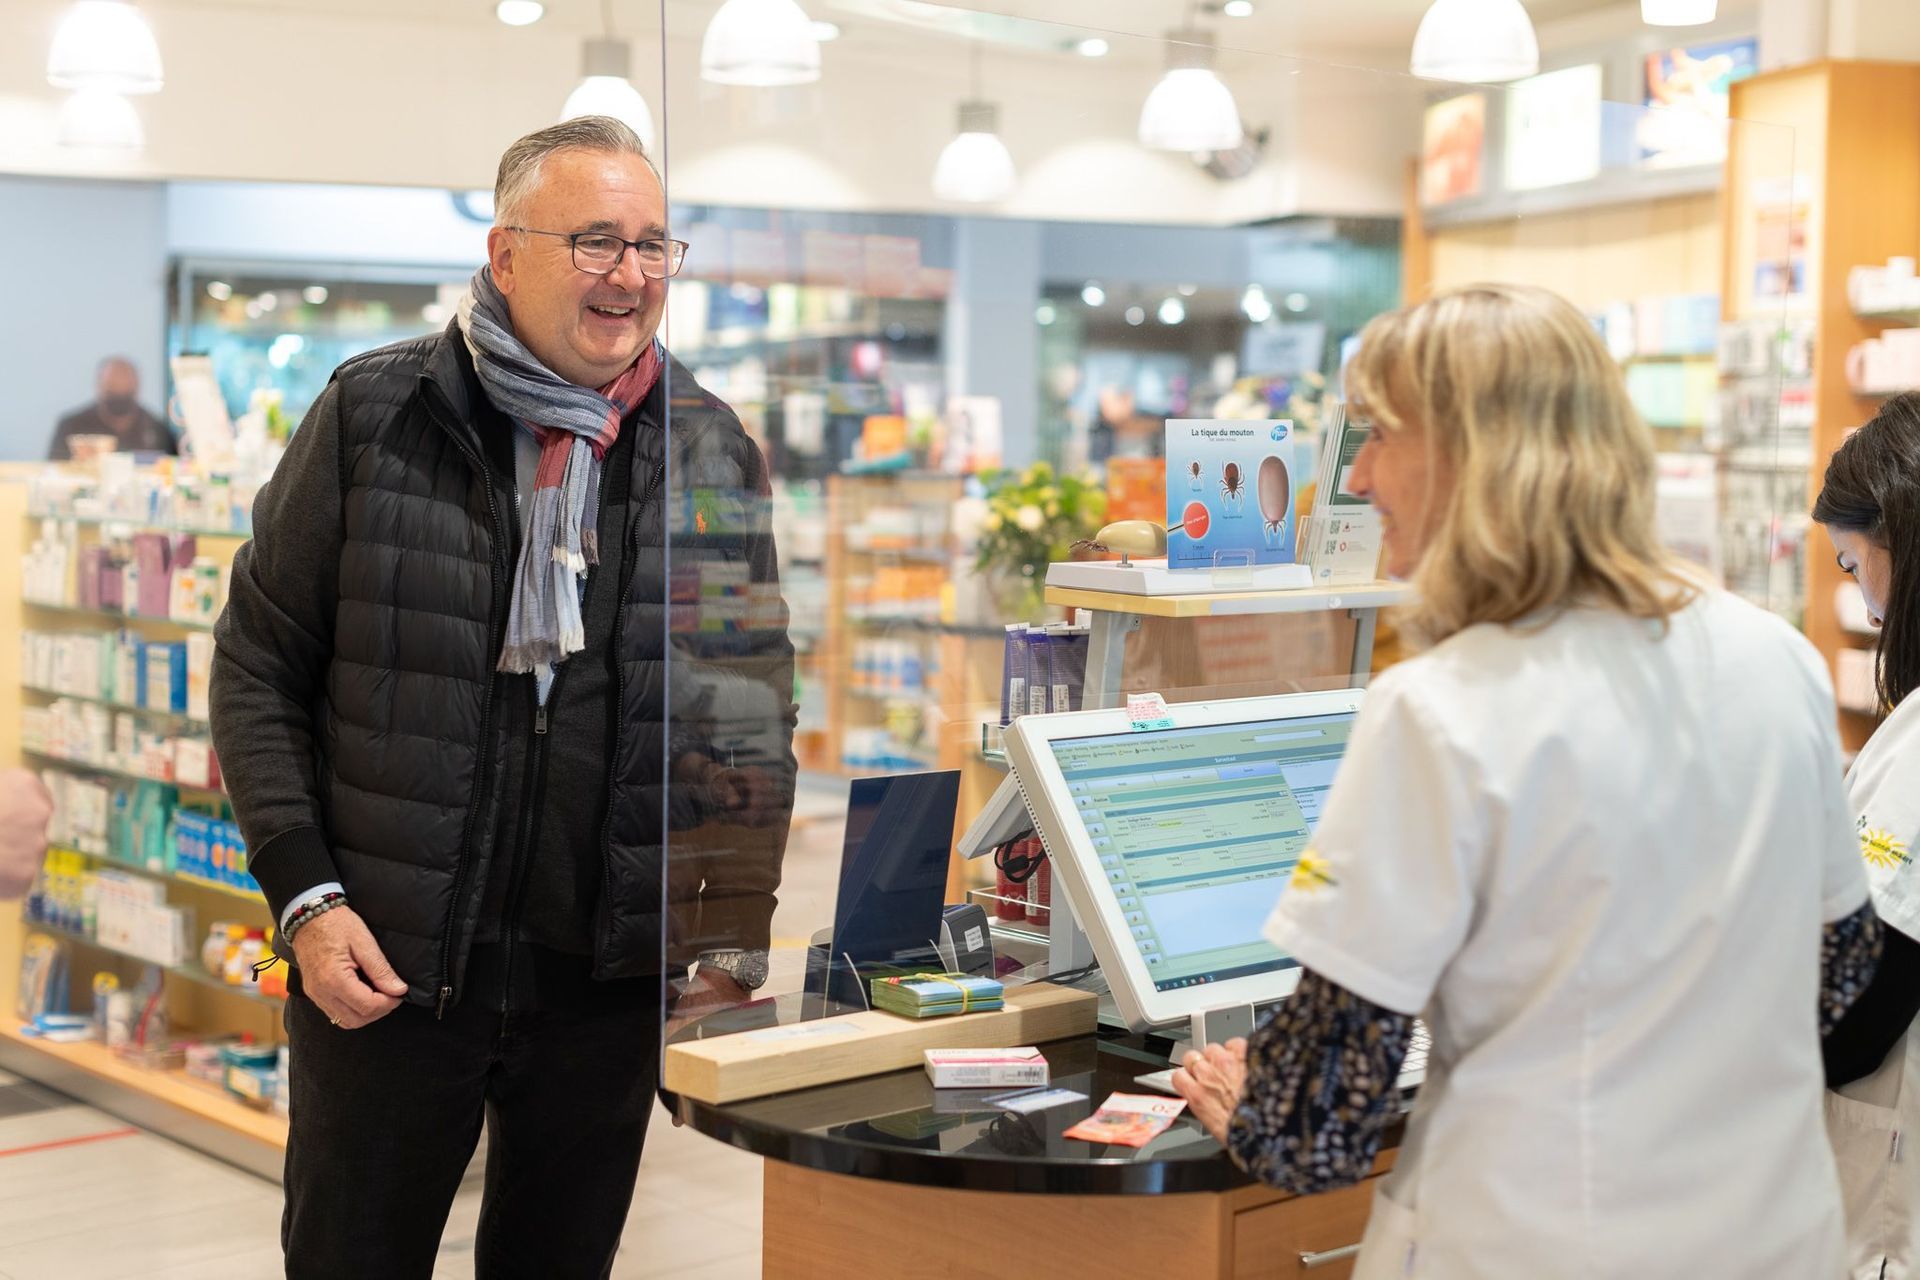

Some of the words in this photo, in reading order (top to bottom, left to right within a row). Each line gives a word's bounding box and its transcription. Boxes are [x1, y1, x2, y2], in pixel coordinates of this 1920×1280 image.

[1191, 428, 1199, 436] La
[1200, 428, 1218, 438] tique
[1219, 428, 1228, 436] du
[1229, 428, 1254, 436] mouton
